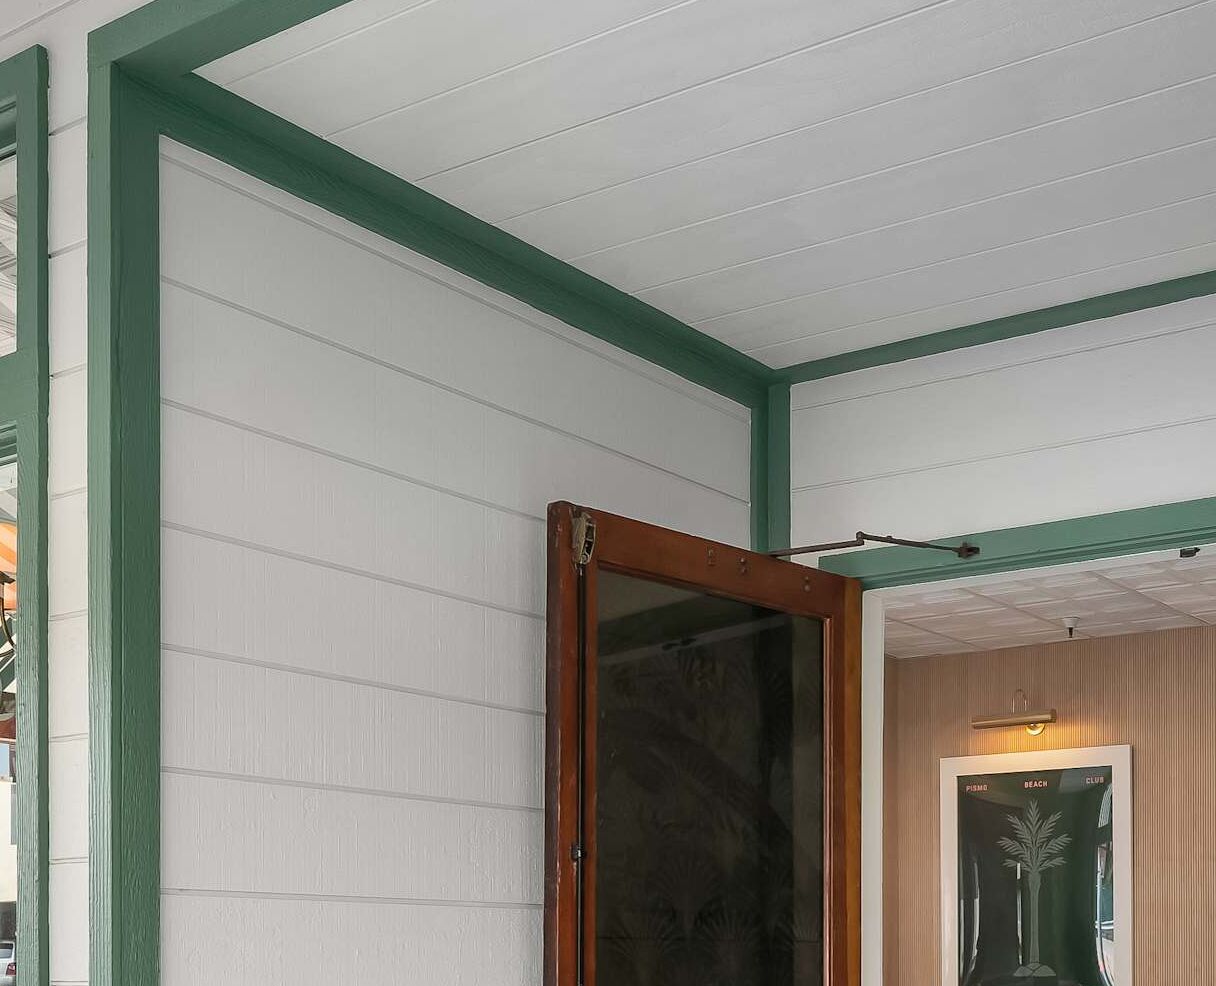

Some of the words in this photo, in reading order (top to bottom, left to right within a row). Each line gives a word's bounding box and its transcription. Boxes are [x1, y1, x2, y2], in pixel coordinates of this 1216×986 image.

[965, 784, 989, 793] PISMO
[1023, 780, 1049, 789] BEACH
[1085, 776, 1105, 785] CLUB
